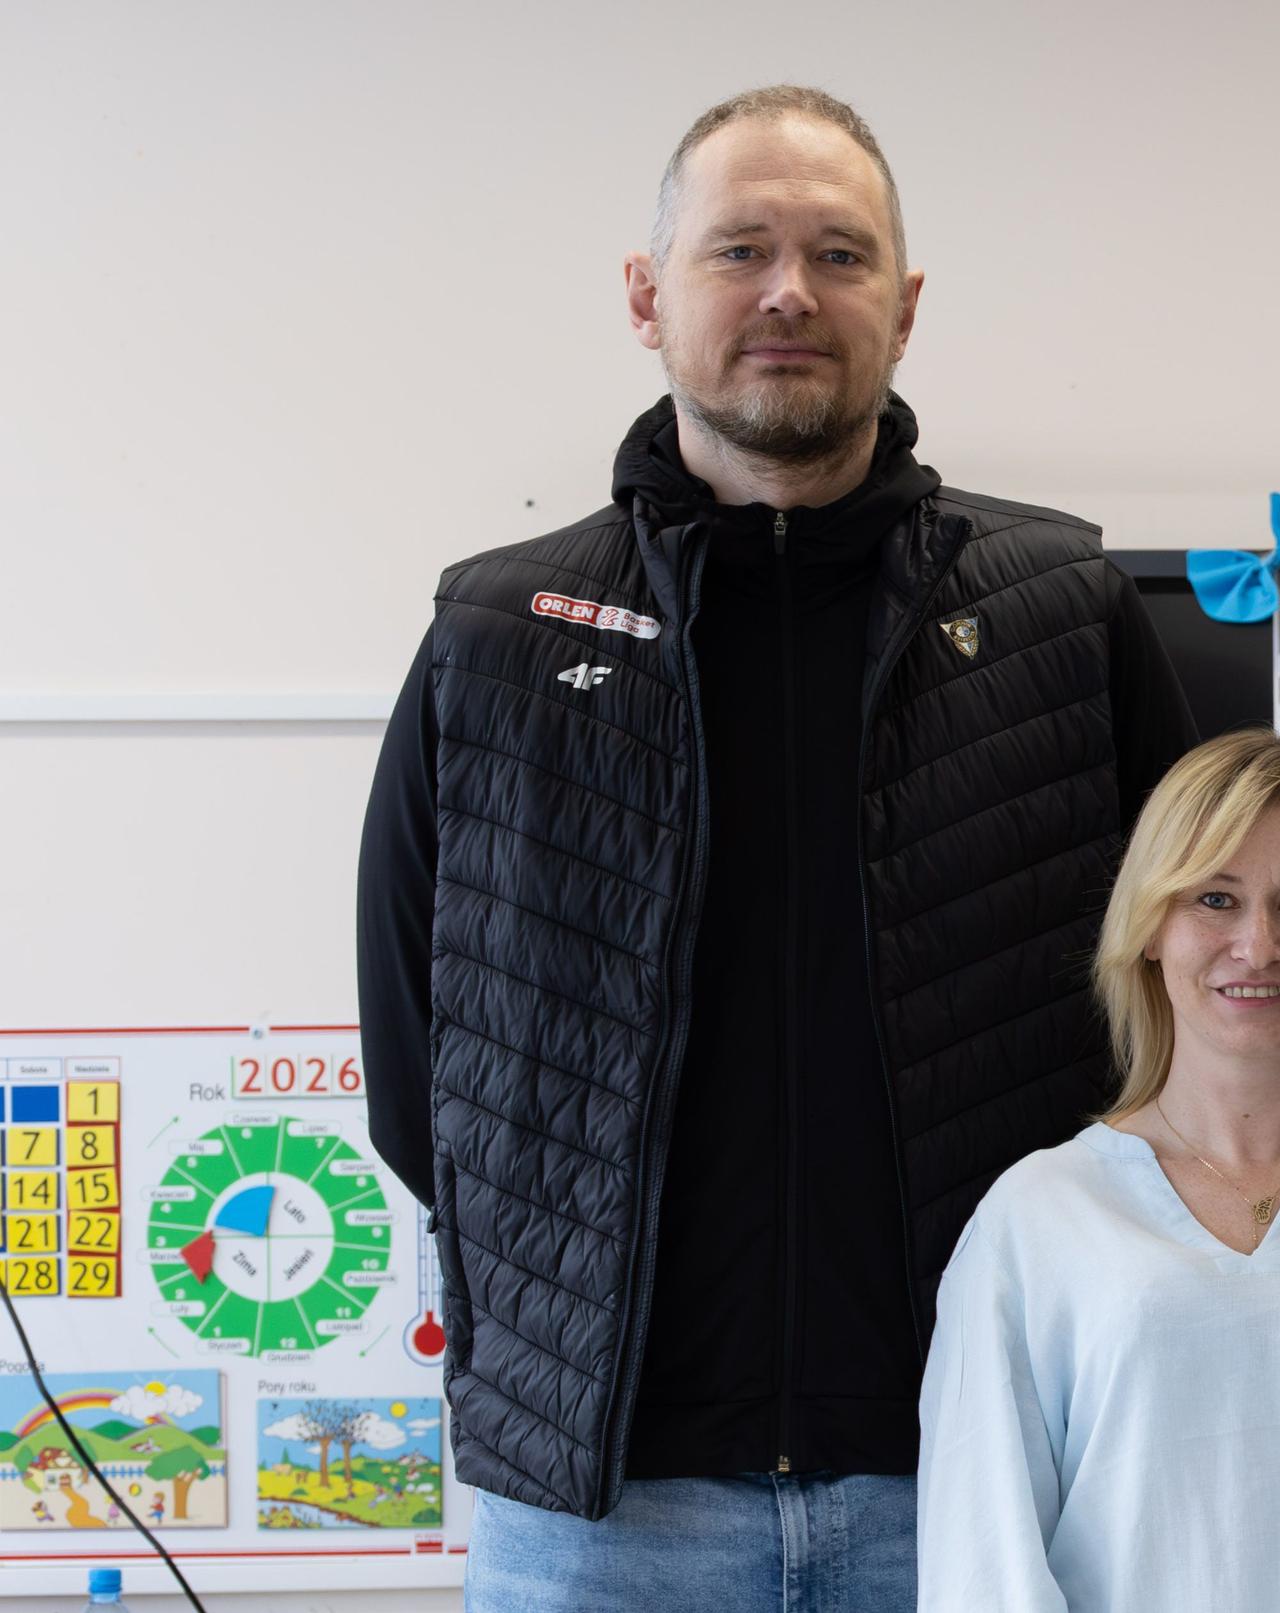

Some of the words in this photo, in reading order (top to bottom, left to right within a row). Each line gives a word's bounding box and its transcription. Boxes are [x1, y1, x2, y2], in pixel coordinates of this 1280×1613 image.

[539, 598, 595, 619] ORLEN
[623, 612, 656, 628] Basket
[620, 620, 639, 634] Liga
[557, 662, 612, 691] 4F
[241, 1057, 361, 1093] 2026
[88, 1087, 98, 1115] 1
[189, 1082, 225, 1101] Rok
[22, 1131, 40, 1160] 7
[81, 1130, 98, 1160] 8
[13, 1176, 50, 1205] 14
[75, 1173, 110, 1203] 15
[283, 1200, 306, 1224] Lato
[15, 1218, 49, 1248] 21
[75, 1216, 112, 1247] 22
[13, 1260, 52, 1291] 28
[72, 1261, 110, 1292] 29
[232, 1249, 257, 1278] Zima
[258, 1380, 285, 1394] Pory
[288, 1379, 316, 1392] roku
